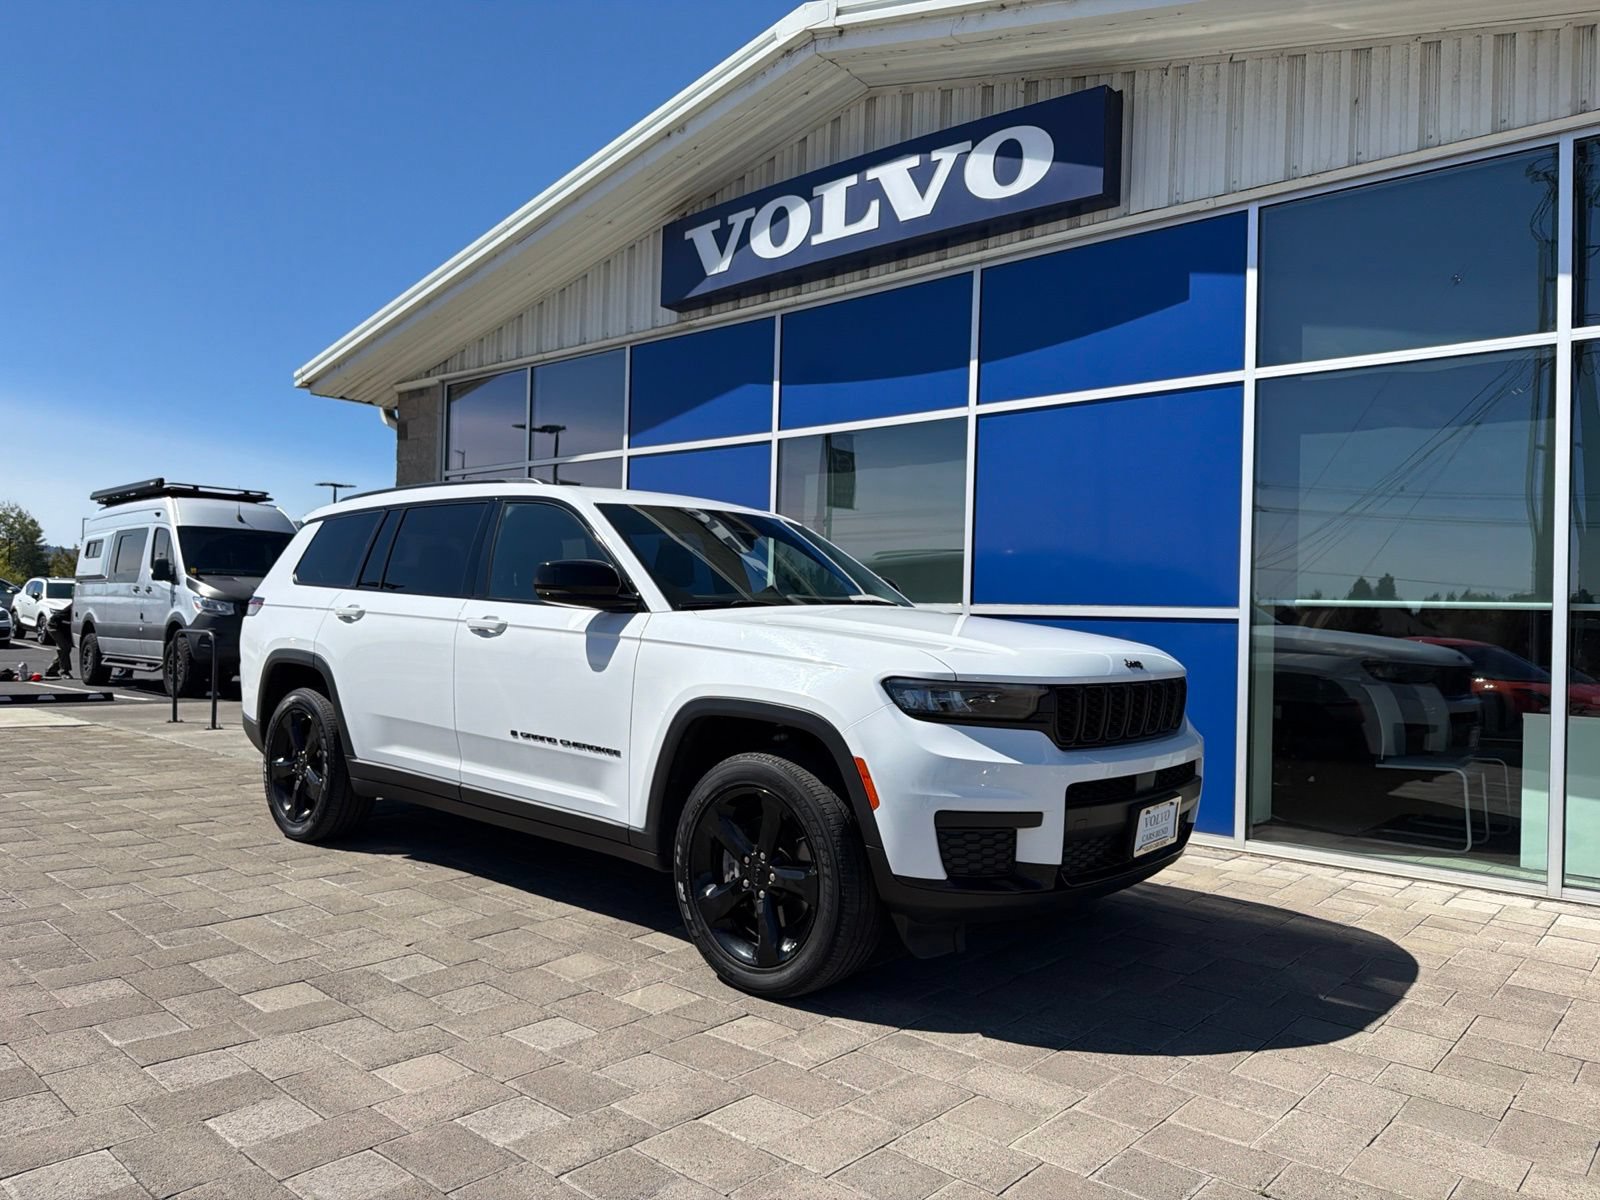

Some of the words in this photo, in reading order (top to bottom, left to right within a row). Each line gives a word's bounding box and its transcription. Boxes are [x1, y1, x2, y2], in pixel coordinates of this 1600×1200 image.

[684, 125, 1055, 277] VOLVO
[520, 732, 558, 744] GRAND
[560, 739, 621, 758] CHEROKEE
[1144, 809, 1171, 828] VOLVO
